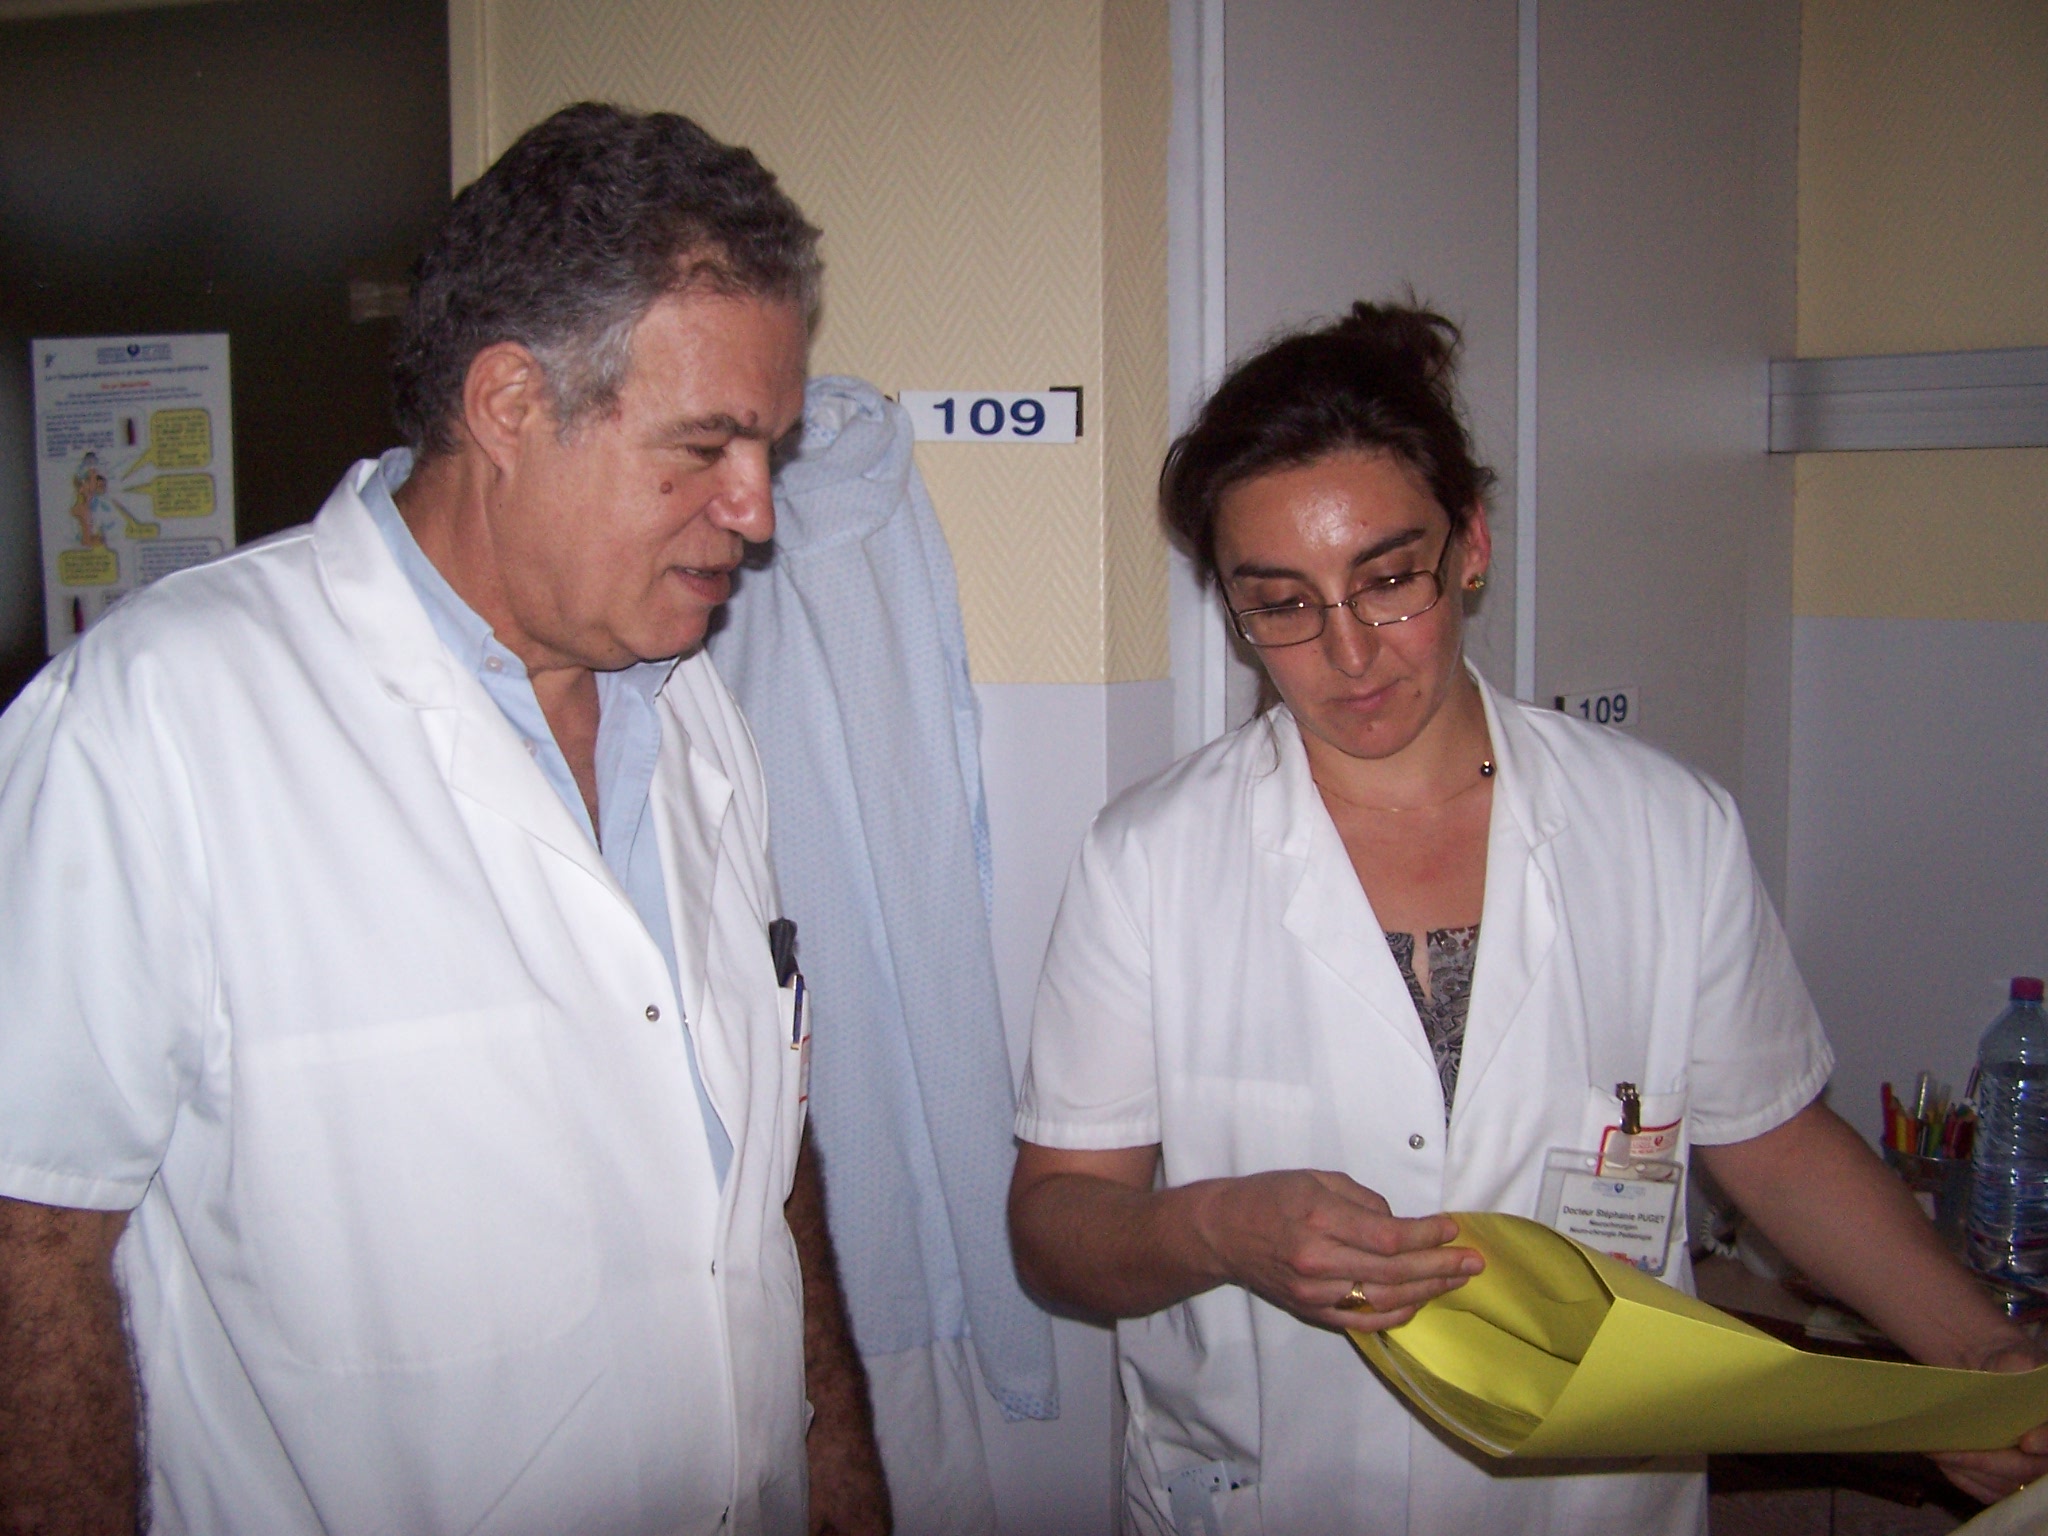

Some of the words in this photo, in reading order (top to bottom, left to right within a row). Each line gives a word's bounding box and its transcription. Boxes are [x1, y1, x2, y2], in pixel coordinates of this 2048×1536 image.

[933, 397, 1046, 437] 109
[1580, 693, 1627, 723] 109
[1563, 1205, 1594, 1217] Docteur
